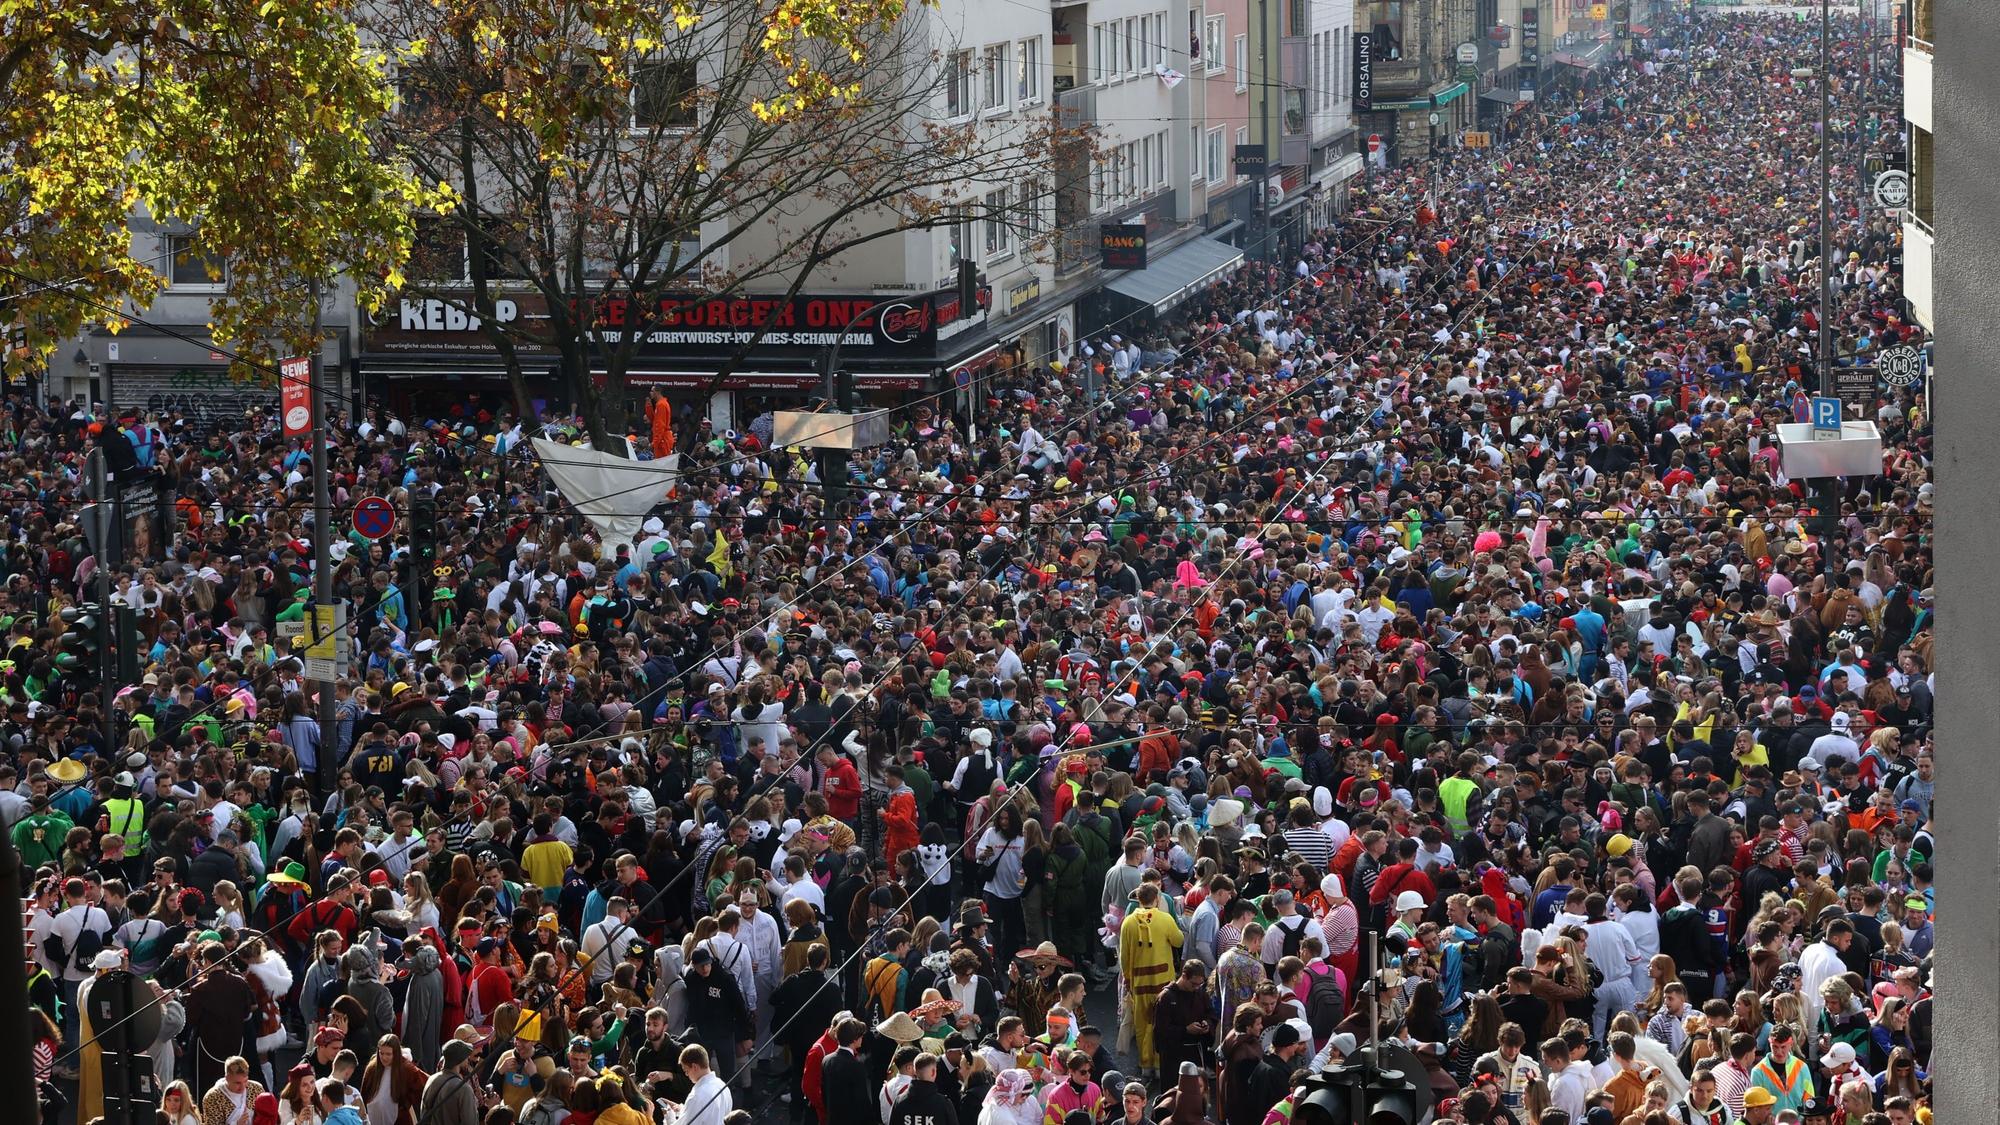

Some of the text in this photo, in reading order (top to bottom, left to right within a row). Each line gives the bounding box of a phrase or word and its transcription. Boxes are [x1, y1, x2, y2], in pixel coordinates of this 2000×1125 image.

[1236, 155, 1264, 164] duma
[660, 299, 795, 326] BURGER
[806, 299, 874, 327] ONE
[1882, 347, 1918, 363] FRISEUR
[281, 360, 309, 379] REWE
[1892, 358, 1908, 373] K&B
[1882, 369, 1918, 385] 9383320
[1819, 402, 1834, 424] P
[367, 755, 393, 774] FBI
[1708, 909, 1719, 923] 9
[708, 986, 721, 999] SEK
[903, 1114, 935, 1125] SEK
